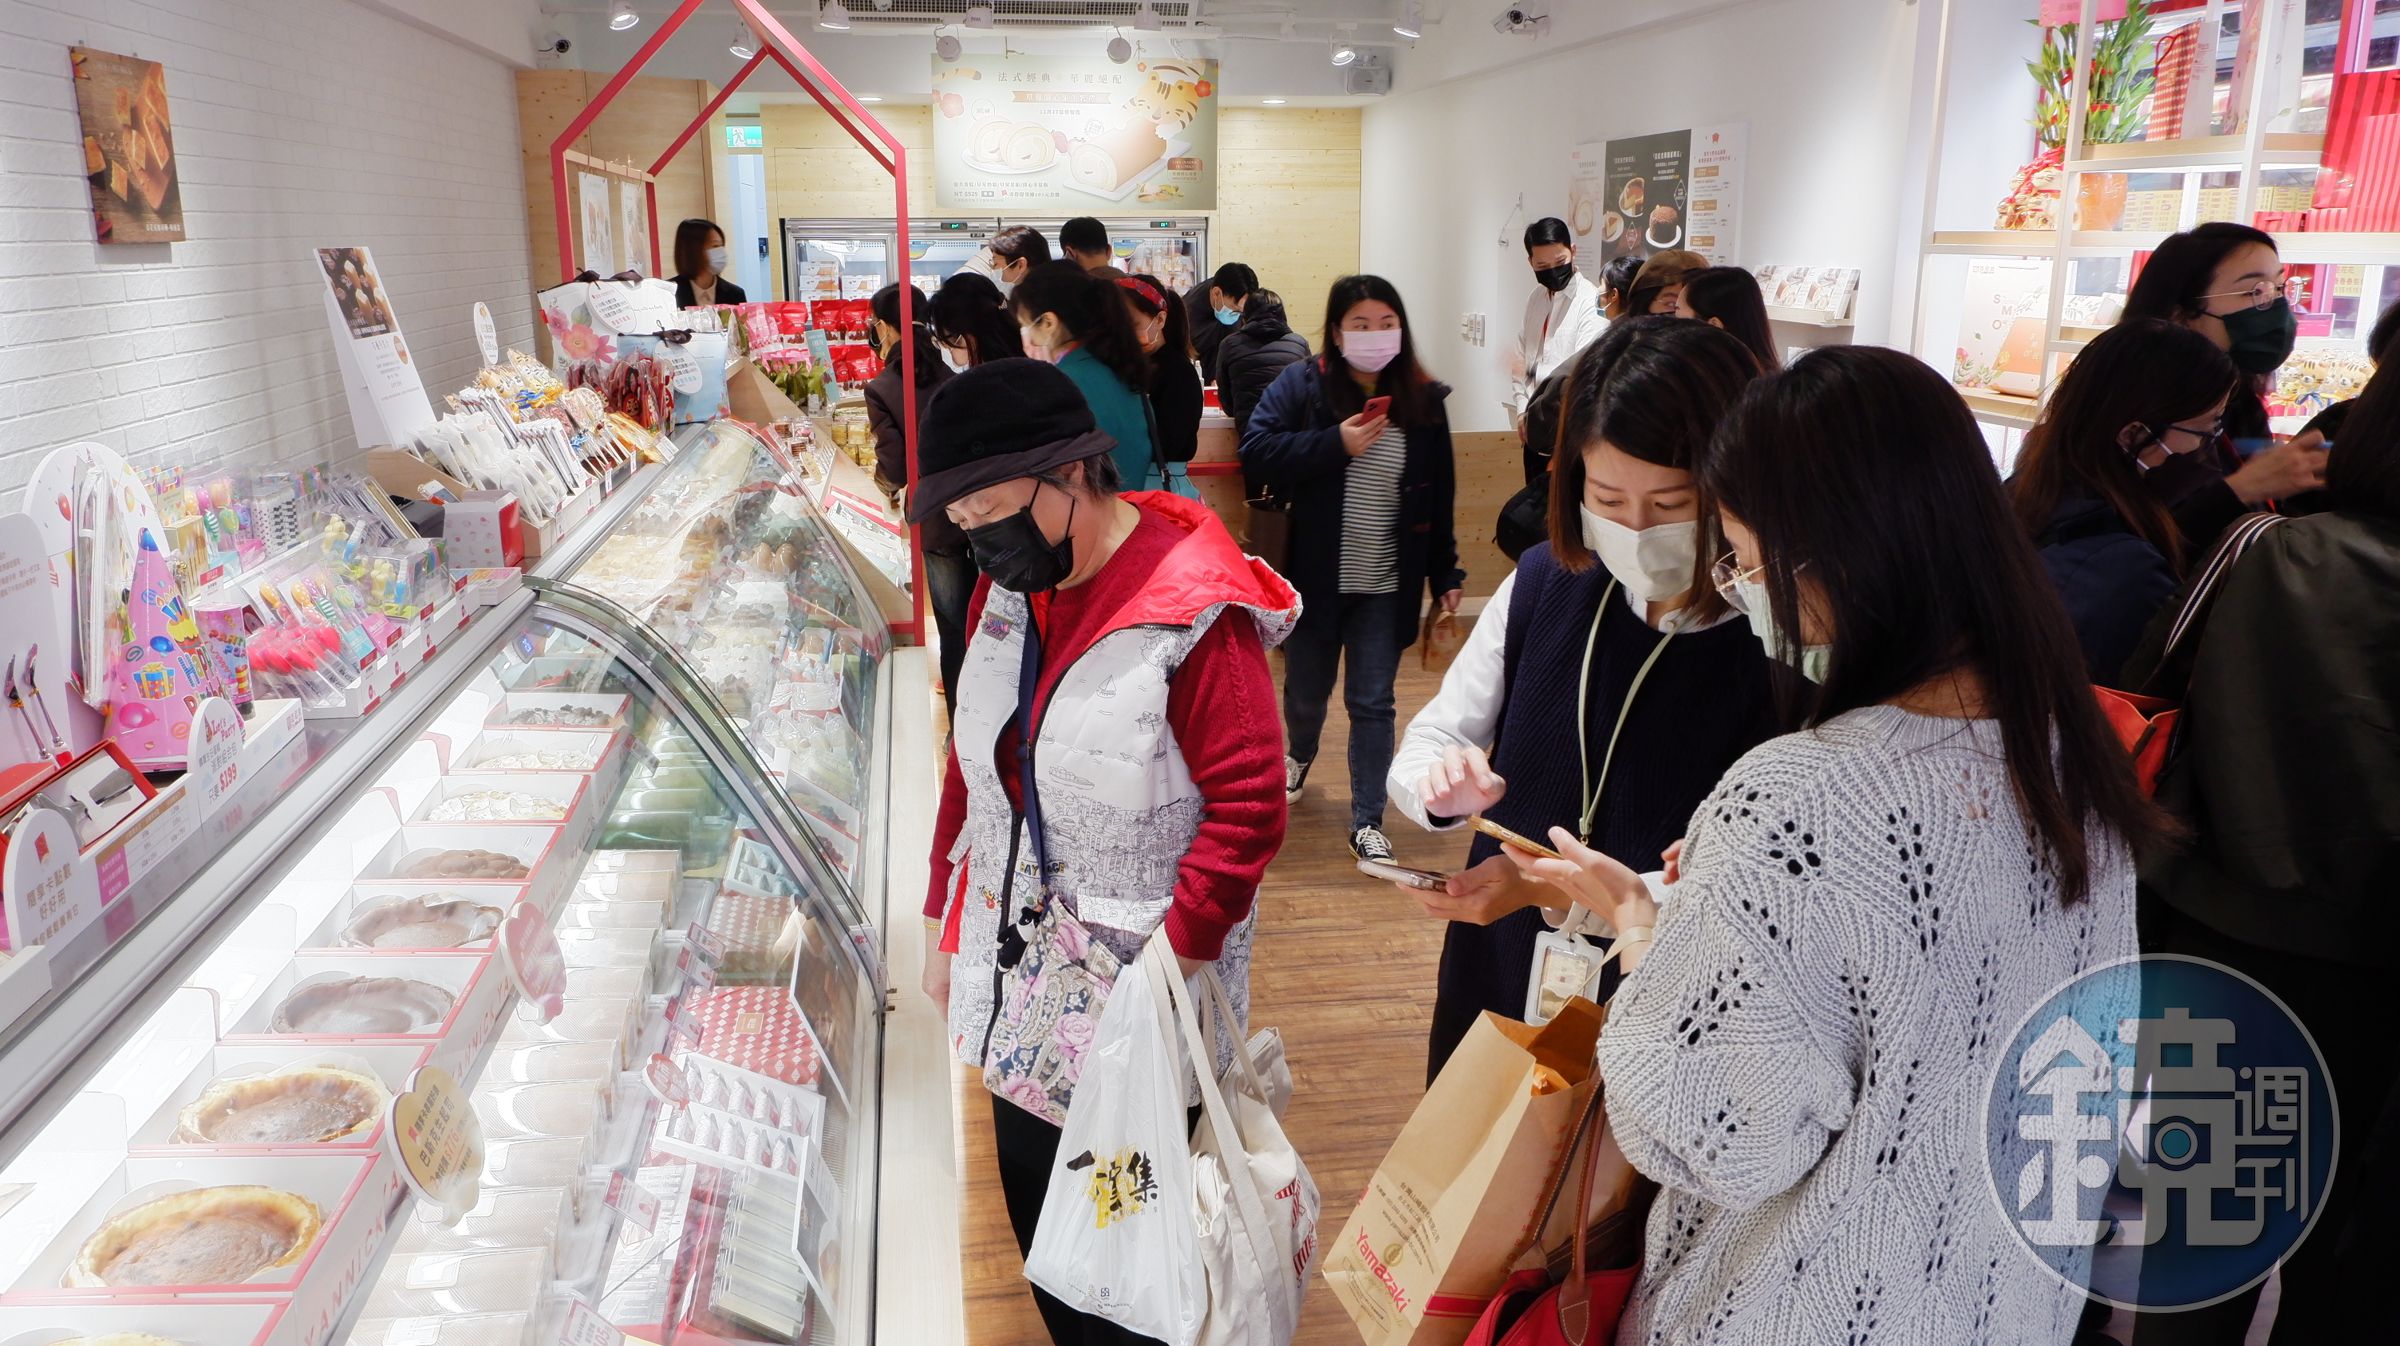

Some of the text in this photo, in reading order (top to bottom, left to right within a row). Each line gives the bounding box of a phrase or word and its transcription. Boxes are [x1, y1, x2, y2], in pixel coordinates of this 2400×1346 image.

[418, 1095, 455, 1168] 巴斯克生起司
[1356, 1224, 1411, 1313] Yamazaki
